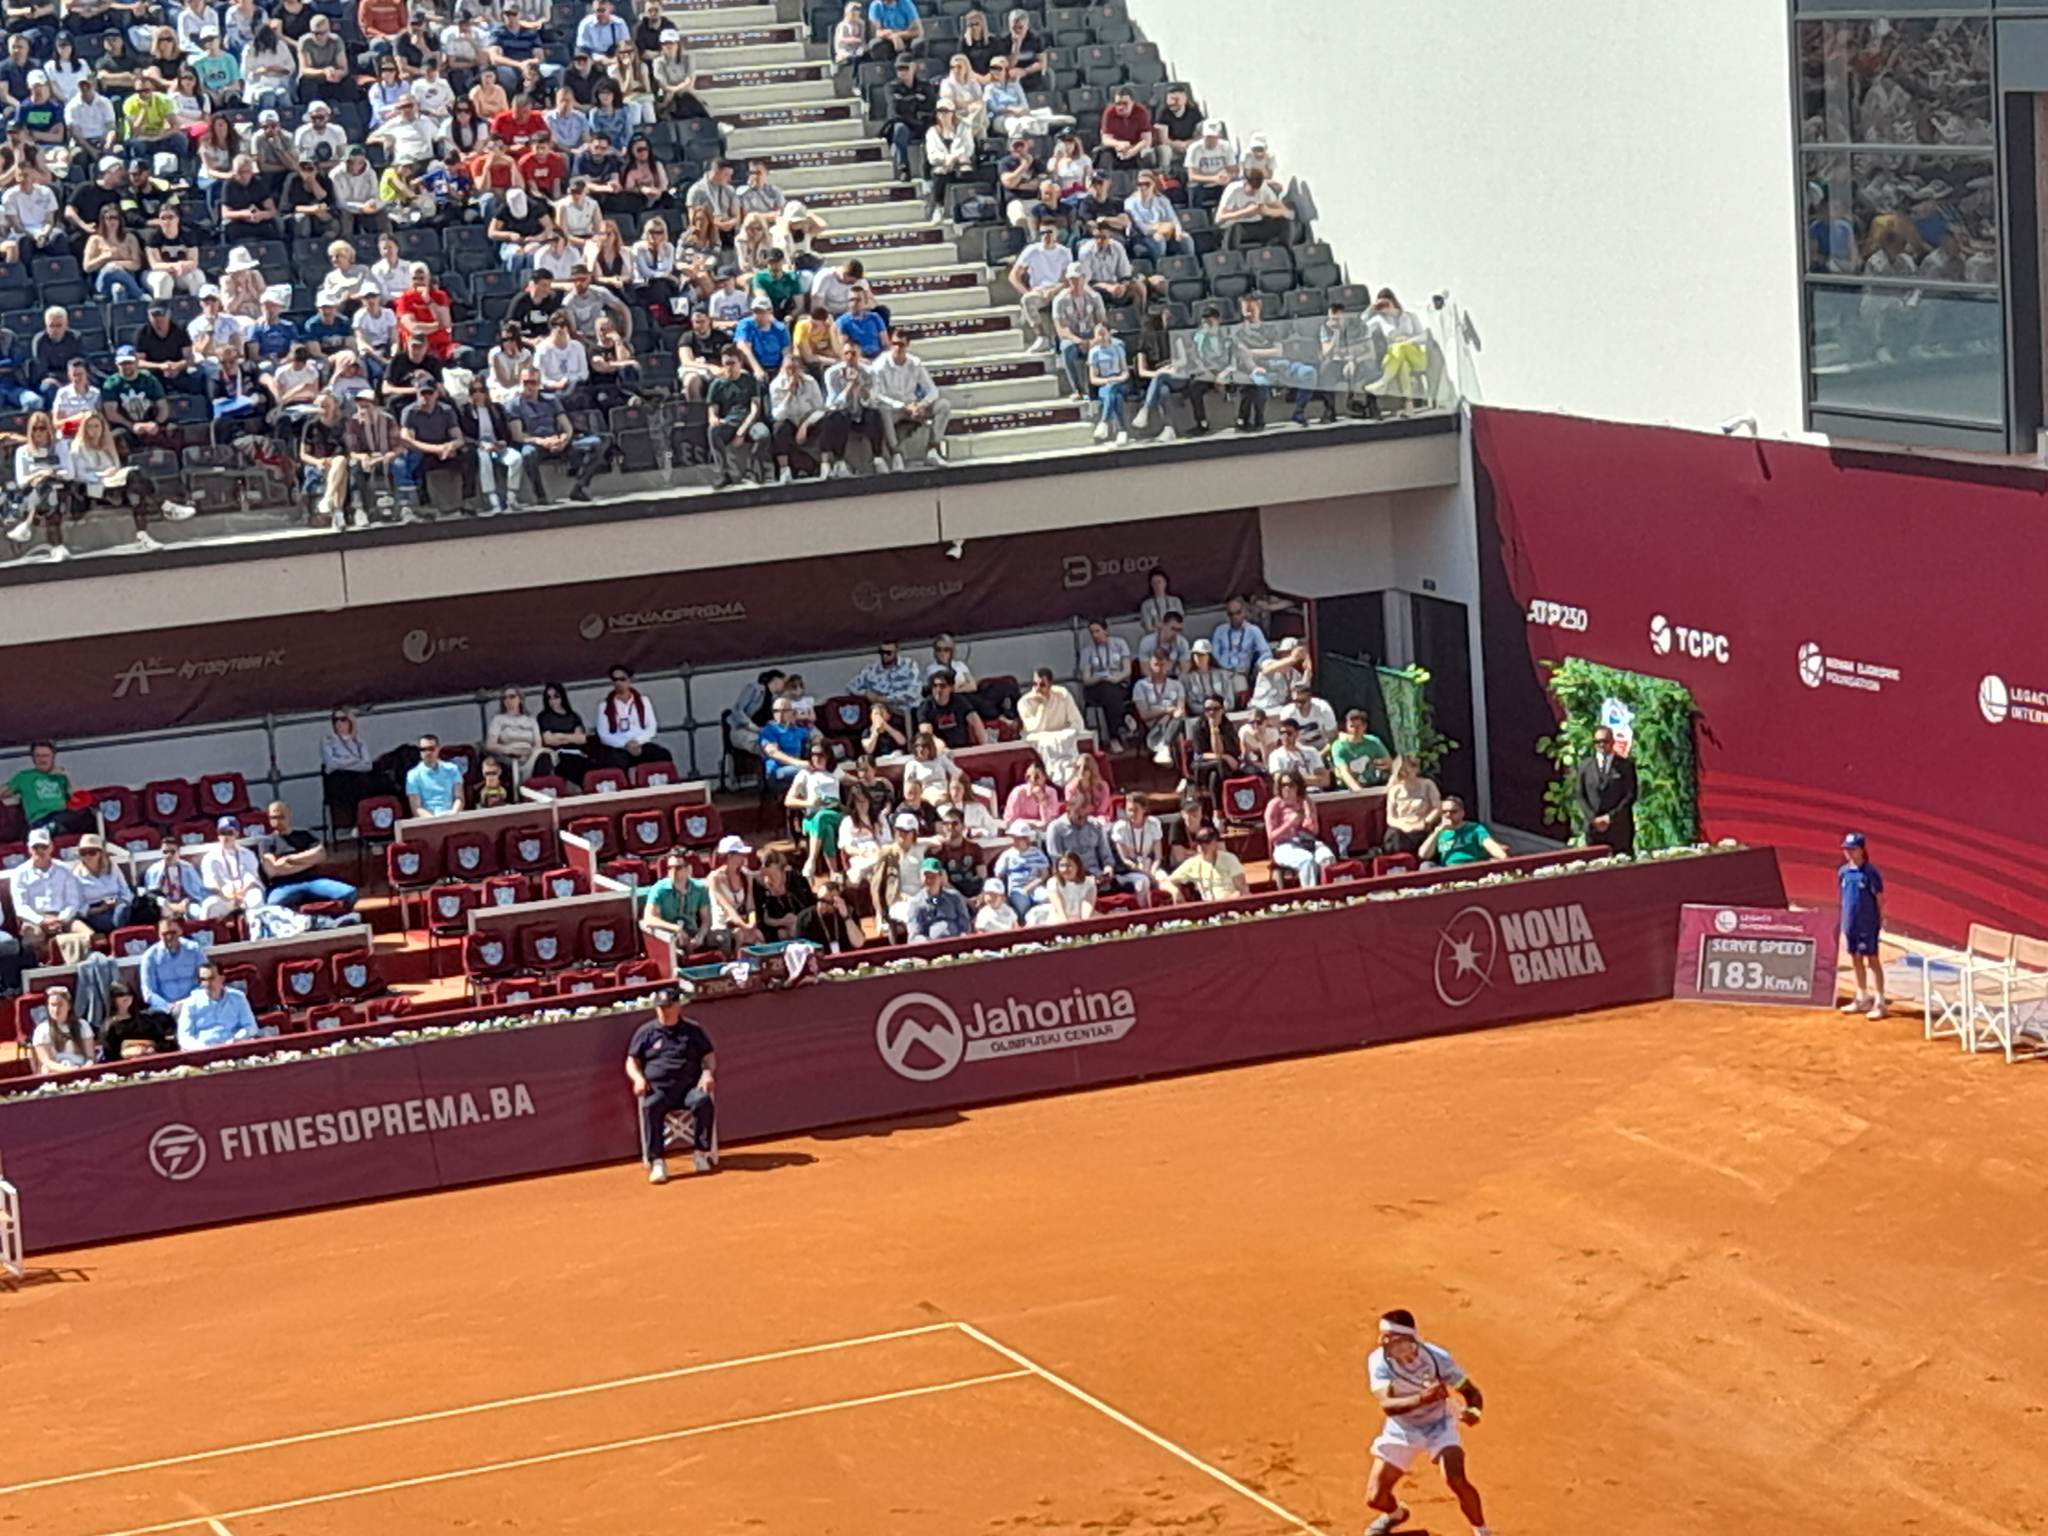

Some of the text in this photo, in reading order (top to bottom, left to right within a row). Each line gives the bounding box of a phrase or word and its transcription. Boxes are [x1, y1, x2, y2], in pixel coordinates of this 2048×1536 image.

[1674, 626, 1730, 664] TCPC
[1500, 903, 1594, 952] NOVA
[1711, 938, 1807, 956] SERVE SPEED
[1509, 941, 1606, 985] BANKA
[1708, 960, 1808, 992] 183 Km/h
[964, 986, 1136, 1039] Jahorina
[1064, 1023, 1115, 1043] CENTAR
[219, 1083, 536, 1162] FITNESOPREMA.BA
